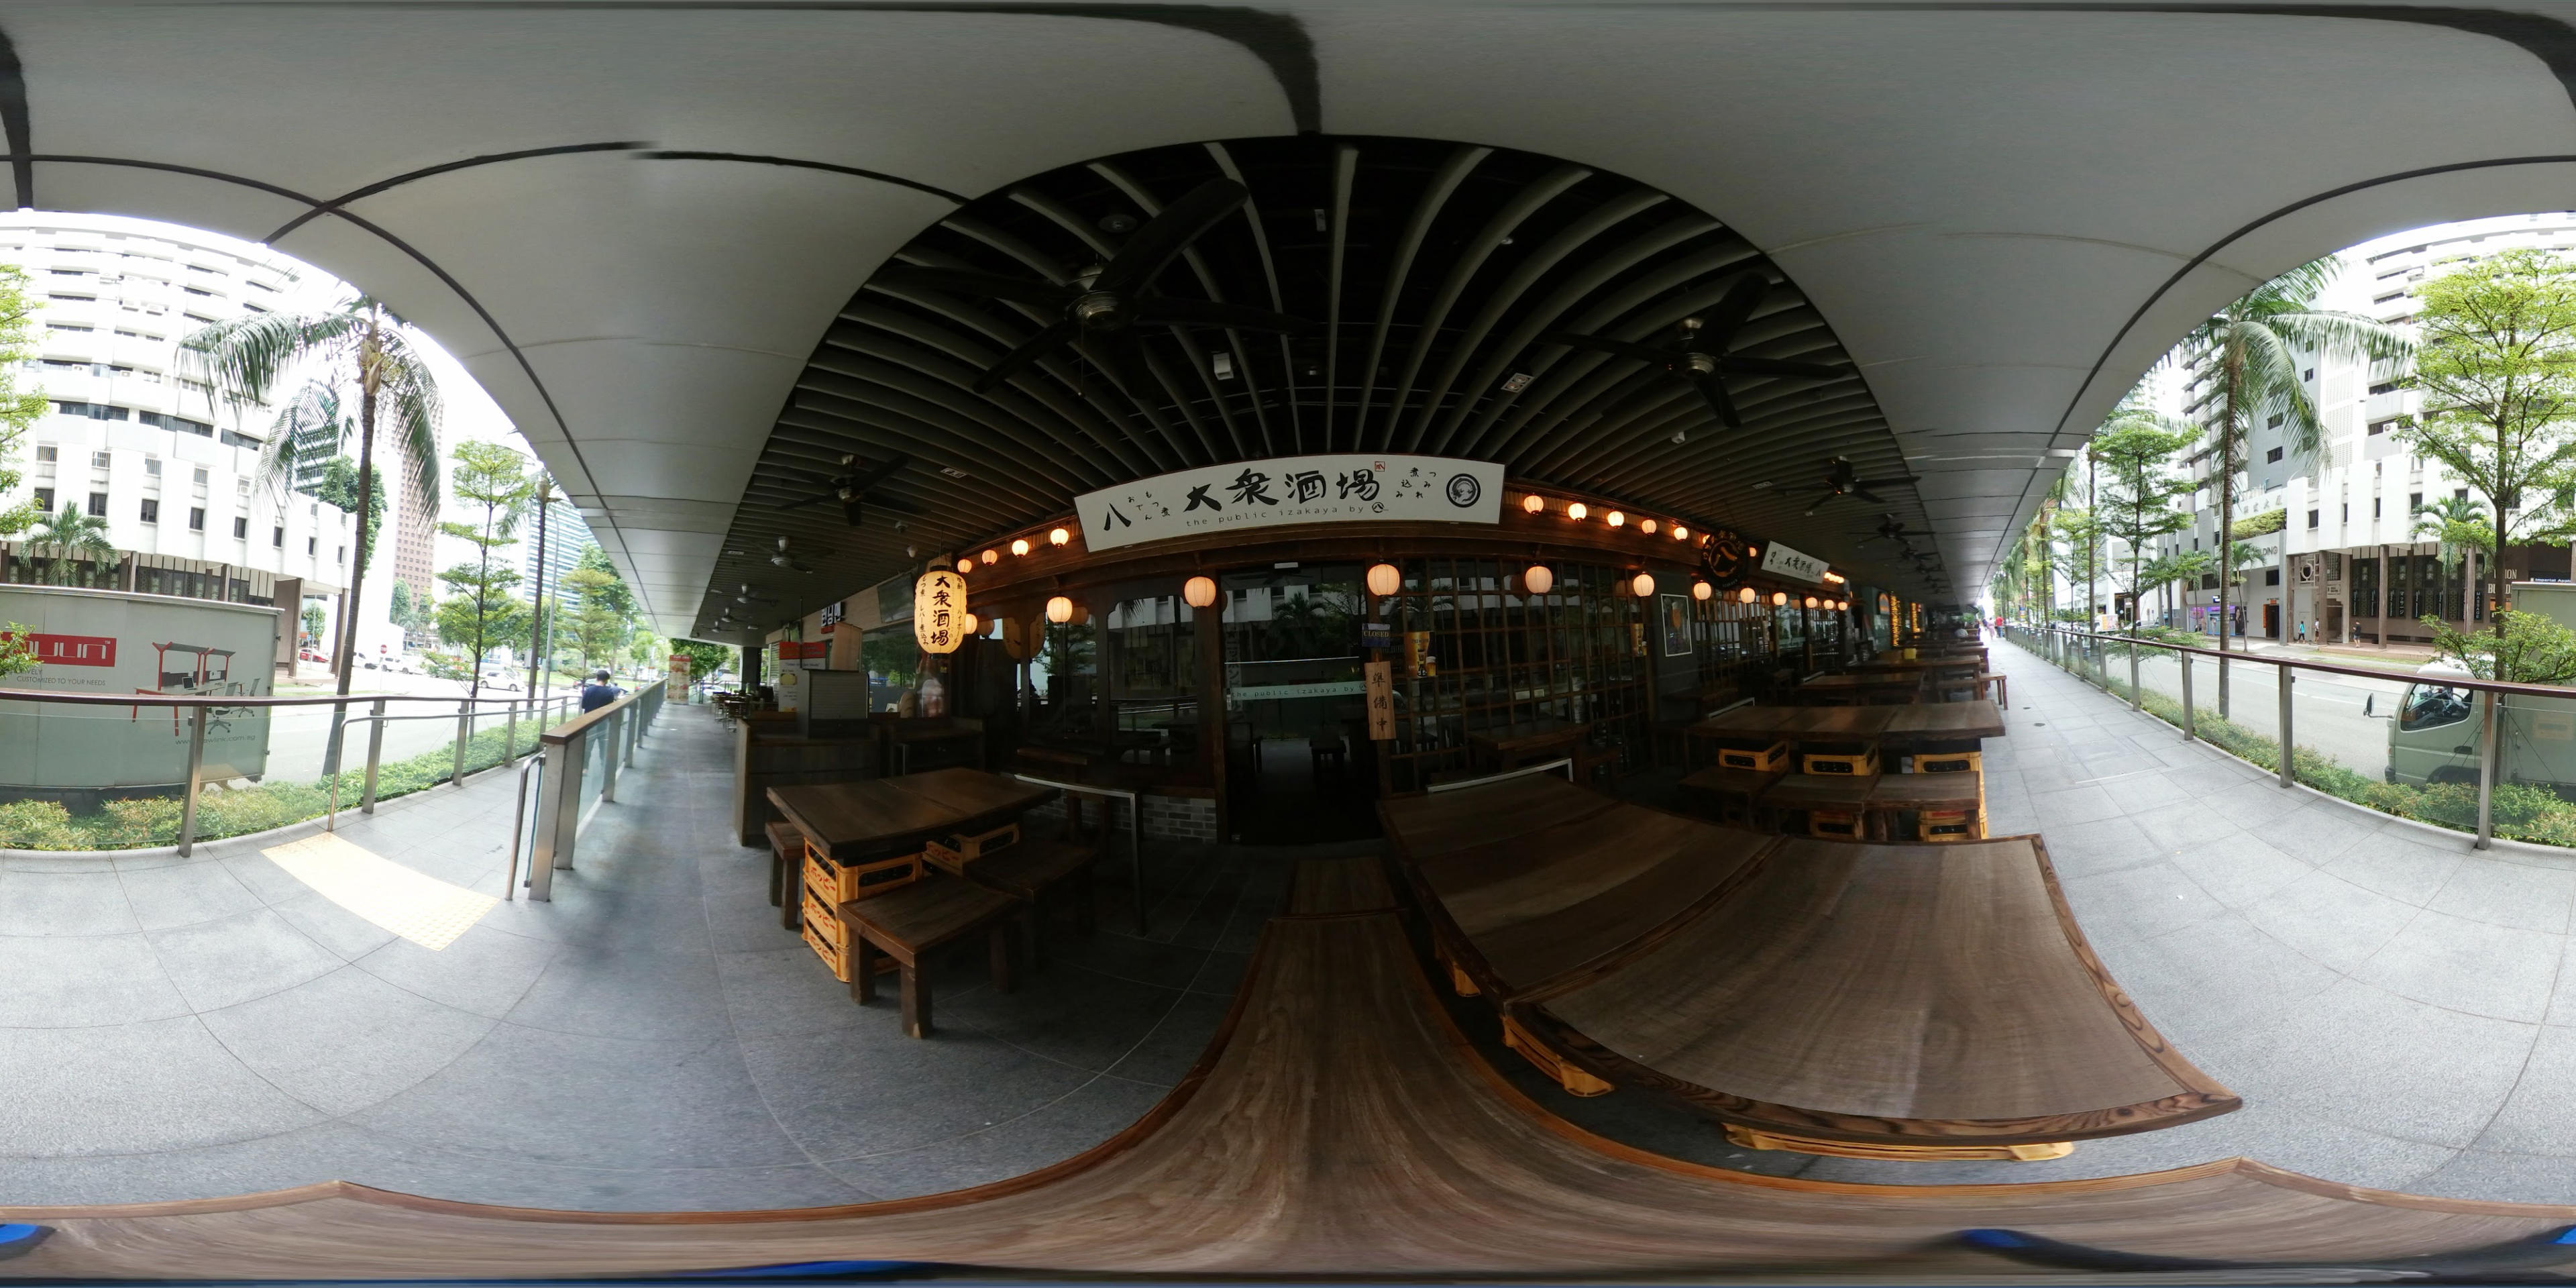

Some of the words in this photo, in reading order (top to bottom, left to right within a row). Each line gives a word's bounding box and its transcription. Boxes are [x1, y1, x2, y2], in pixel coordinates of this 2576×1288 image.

[1183, 468, 1380, 513] 大衆酒場
[1104, 502, 1132, 531] 八
[1186, 518, 1208, 527] the
[1218, 511, 1267, 525] public
[1279, 506, 1338, 517] izakaya
[1349, 504, 1364, 514] by
[2493, 568, 2518, 580] ION
[930, 575, 952, 646] 大衆酒場
[1363, 630, 1390, 638] CLOSED
[1254, 689, 1289, 697] public
[1297, 686, 1337, 694] izakaya
[1372, 672, 1387, 732] 準備中
